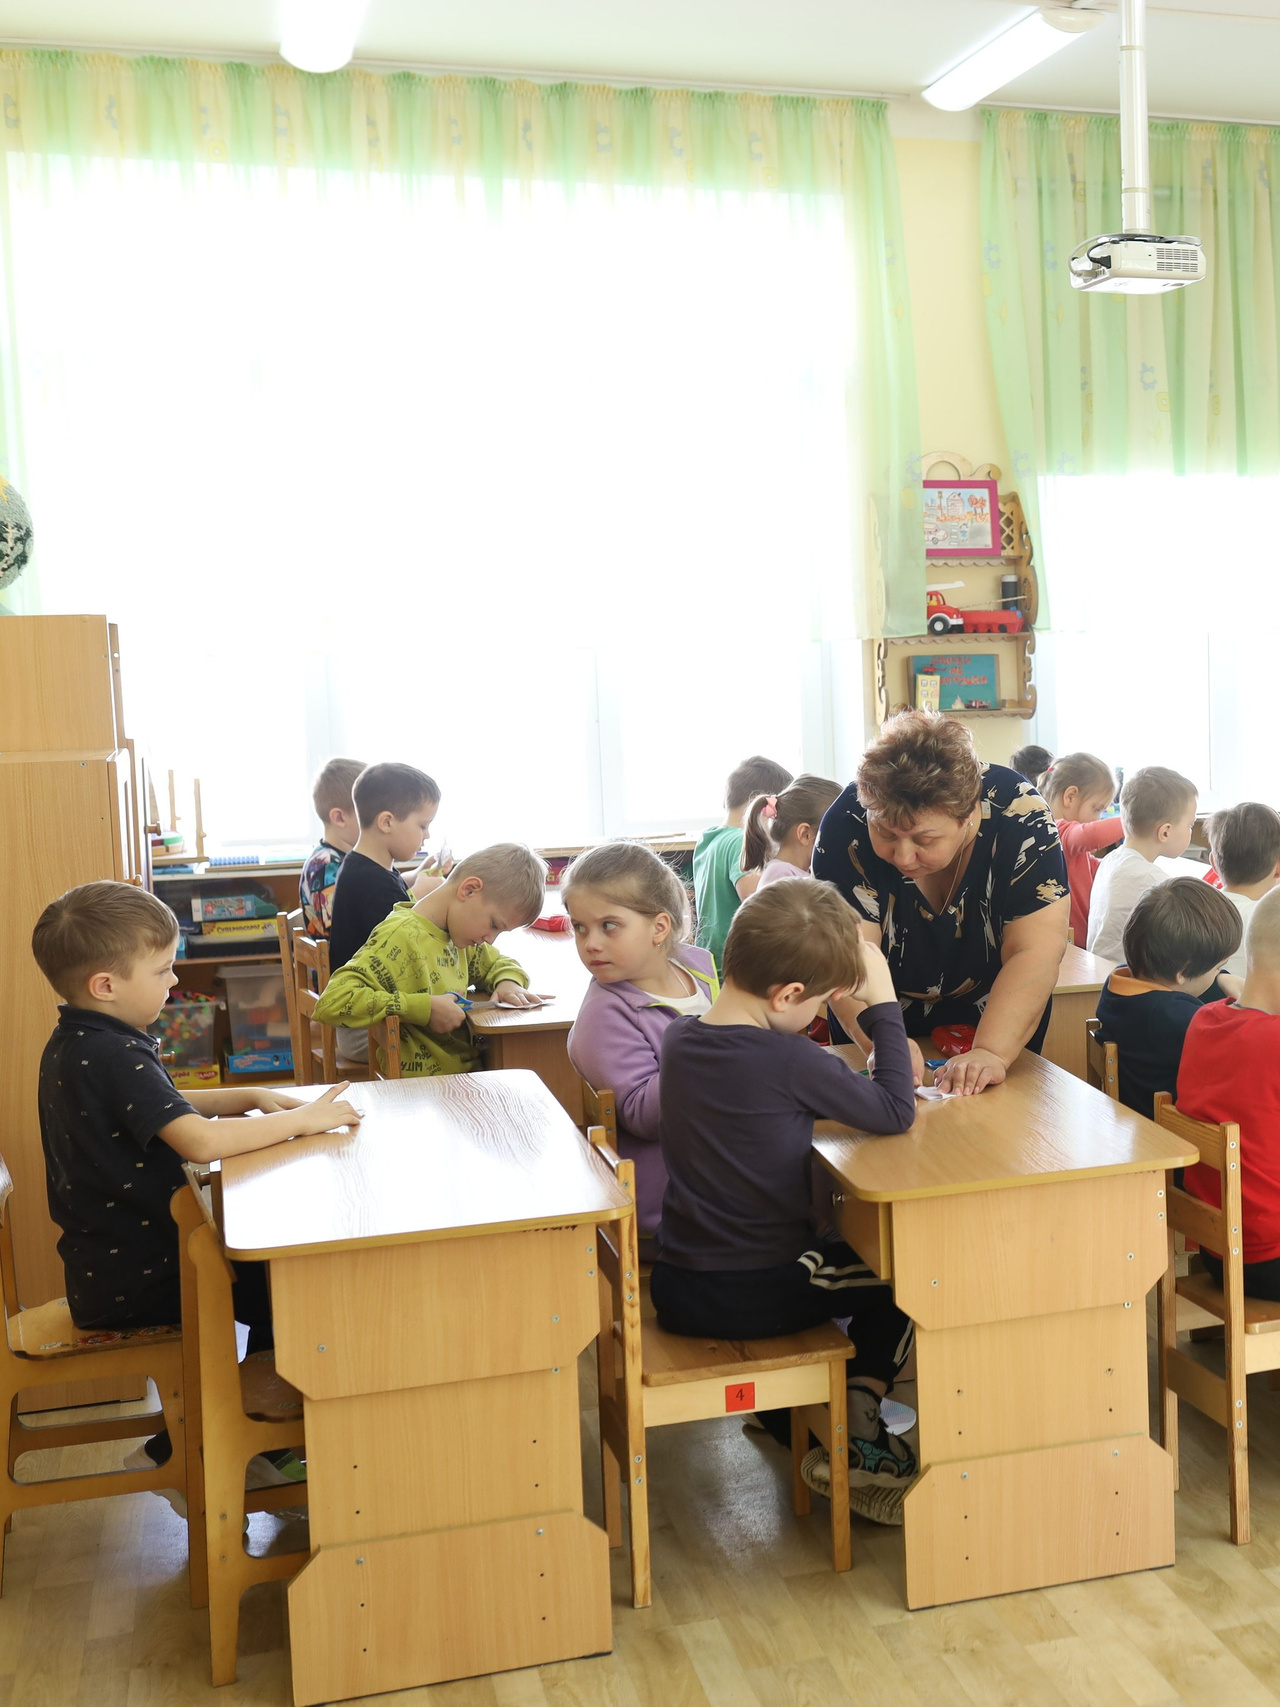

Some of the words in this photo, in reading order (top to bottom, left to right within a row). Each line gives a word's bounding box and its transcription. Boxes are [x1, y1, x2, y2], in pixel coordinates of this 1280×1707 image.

[931, 656, 971, 665] СПИЧКИ
[950, 666, 963, 675] НЕ
[940, 675, 988, 685] ИГРУШКА
[735, 1388, 745, 1401] 4
